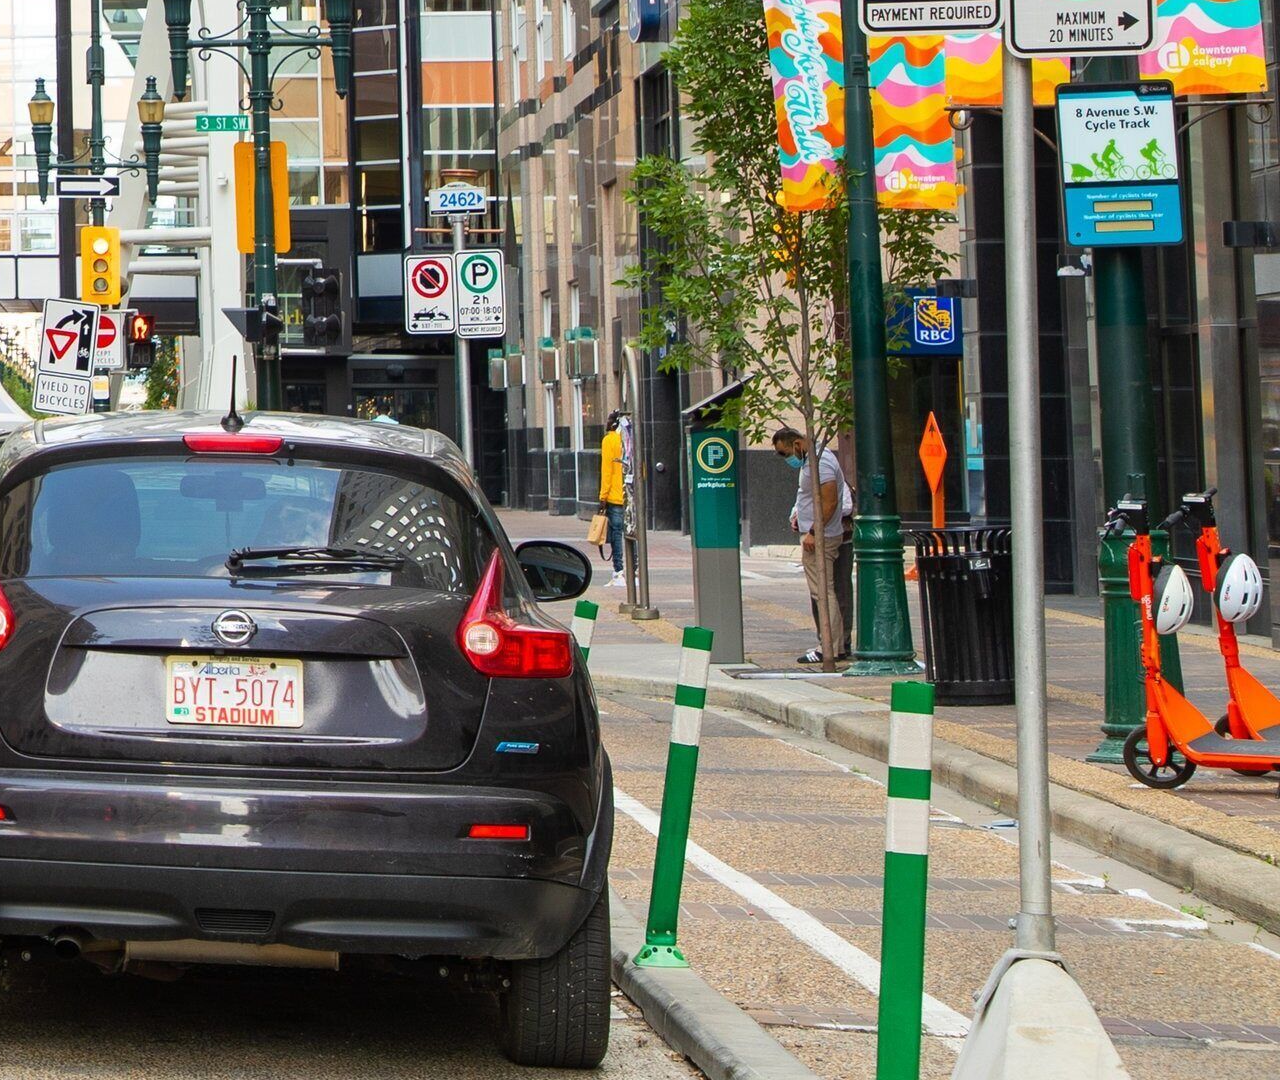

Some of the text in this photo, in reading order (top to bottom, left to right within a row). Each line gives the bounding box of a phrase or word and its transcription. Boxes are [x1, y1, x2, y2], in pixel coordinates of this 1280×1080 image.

[871, 5, 992, 22] PAYMENT REQUIRED
[1056, 11, 1106, 25] MAXIMUM
[1049, 27, 1114, 43] 20 MINUTES
[1192, 45, 1247, 55] downtown
[1193, 56, 1233, 68] calgary
[1075, 105, 1159, 118] 8 Avenue S.W.
[201, 117, 247, 130] 3 ST SW
[1085, 118, 1150, 132] Cycle Track
[907, 174, 946, 182] downtown
[909, 182, 937, 192] calgary
[439, 191, 476, 208] 2462
[471, 262, 489, 286] P
[473, 295, 489, 304] 2 h
[920, 330, 950, 340] RBC
[41, 380, 86, 395] YIELD TO
[39, 393, 85, 409] BICYCLES
[707, 445, 724, 466] P
[198, 663, 241, 676] Alberta
[173, 676, 295, 709] BYT-5074
[195, 706, 275, 725] STADIUM
